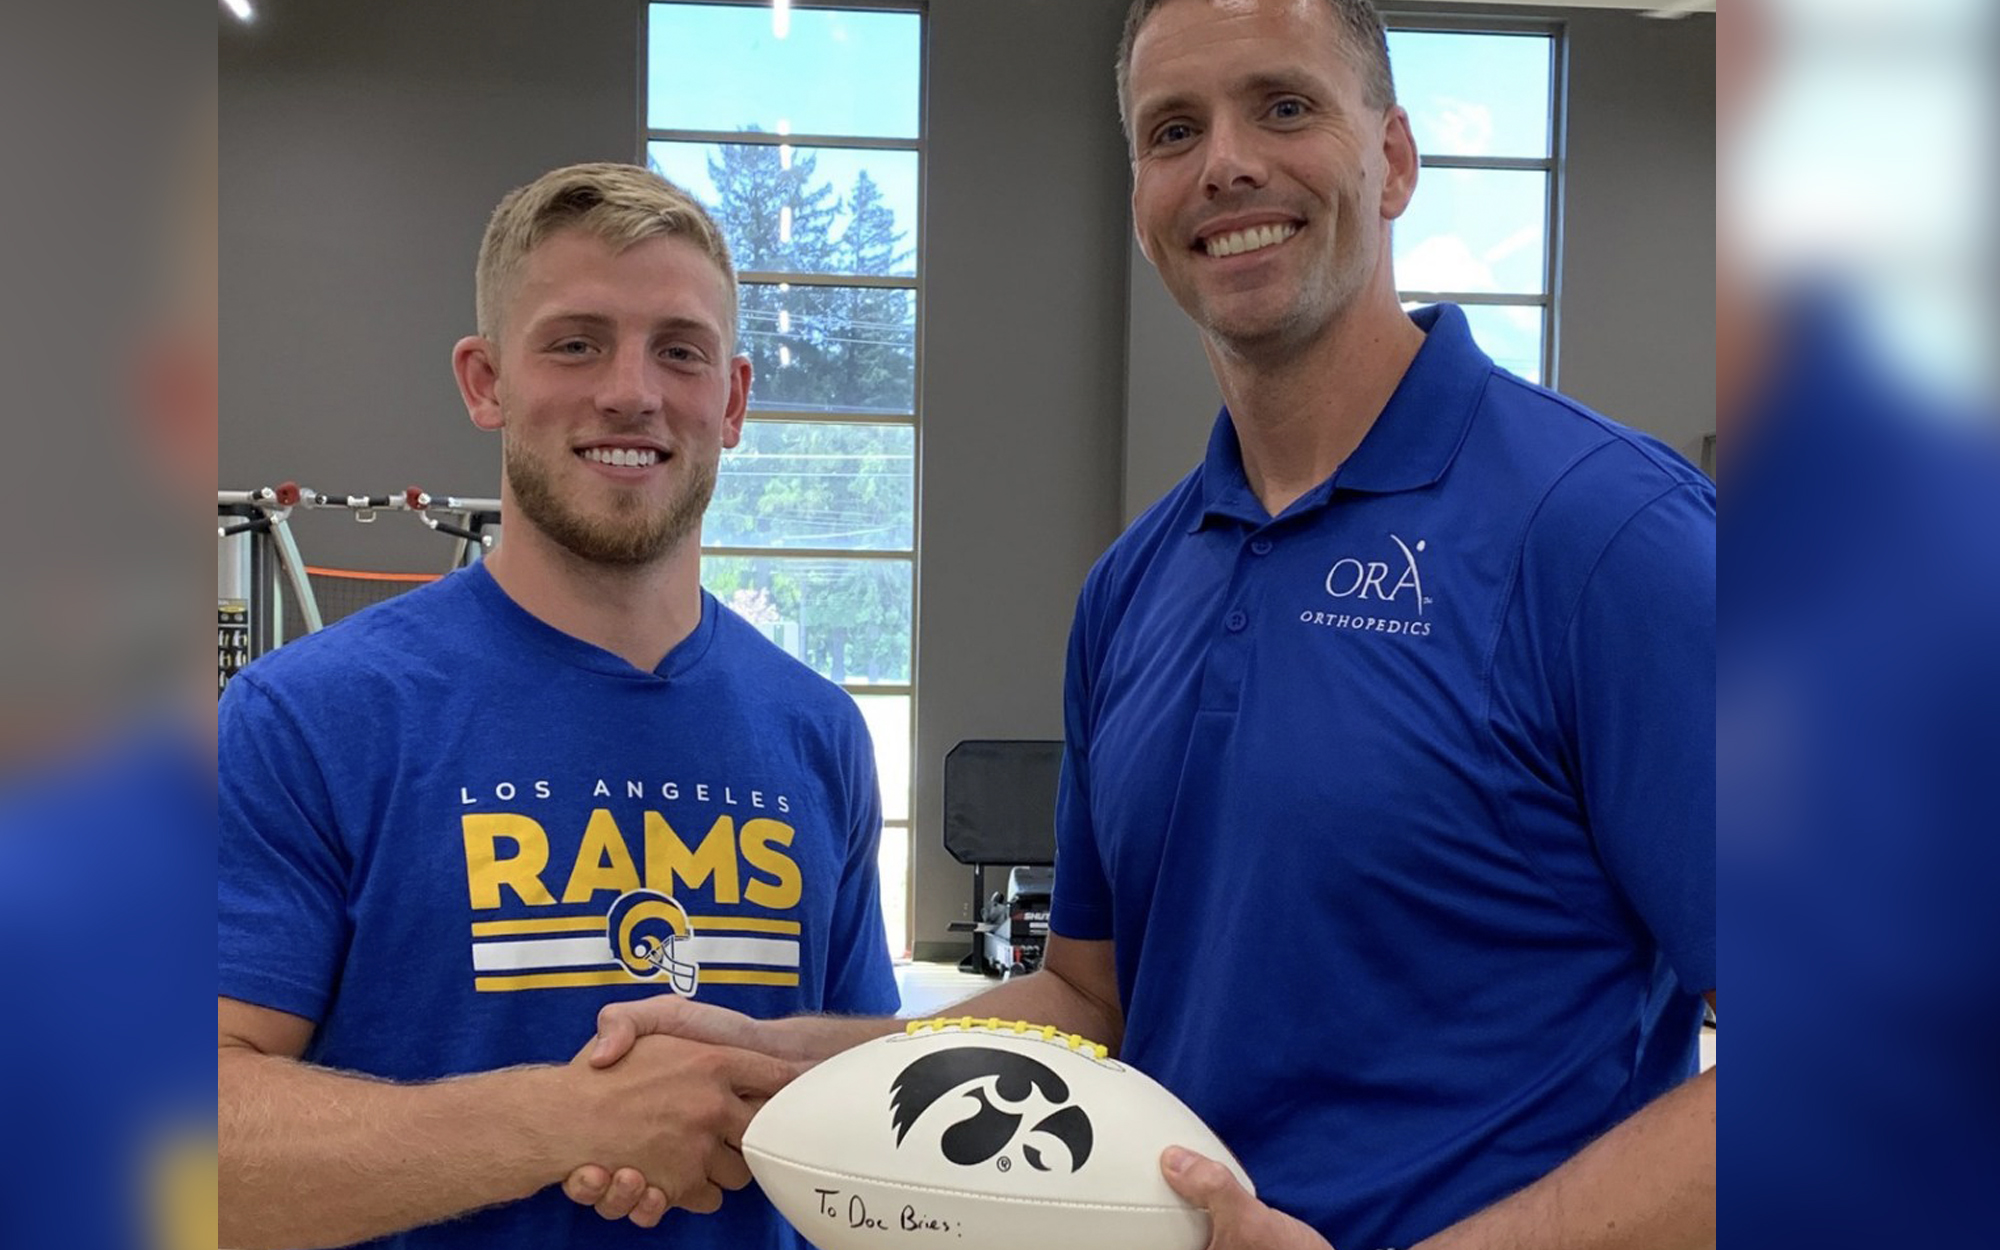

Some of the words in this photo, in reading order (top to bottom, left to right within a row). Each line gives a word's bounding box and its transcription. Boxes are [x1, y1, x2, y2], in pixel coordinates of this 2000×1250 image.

[1325, 534, 1423, 616] ORA
[1299, 610, 1432, 637] ORTHOPEDICS
[461, 780, 551, 805] LOS
[593, 778, 791, 813] ANGELES
[461, 808, 803, 911] RAMS
[814, 1188, 841, 1218] To
[848, 1194, 889, 1230] Doc
